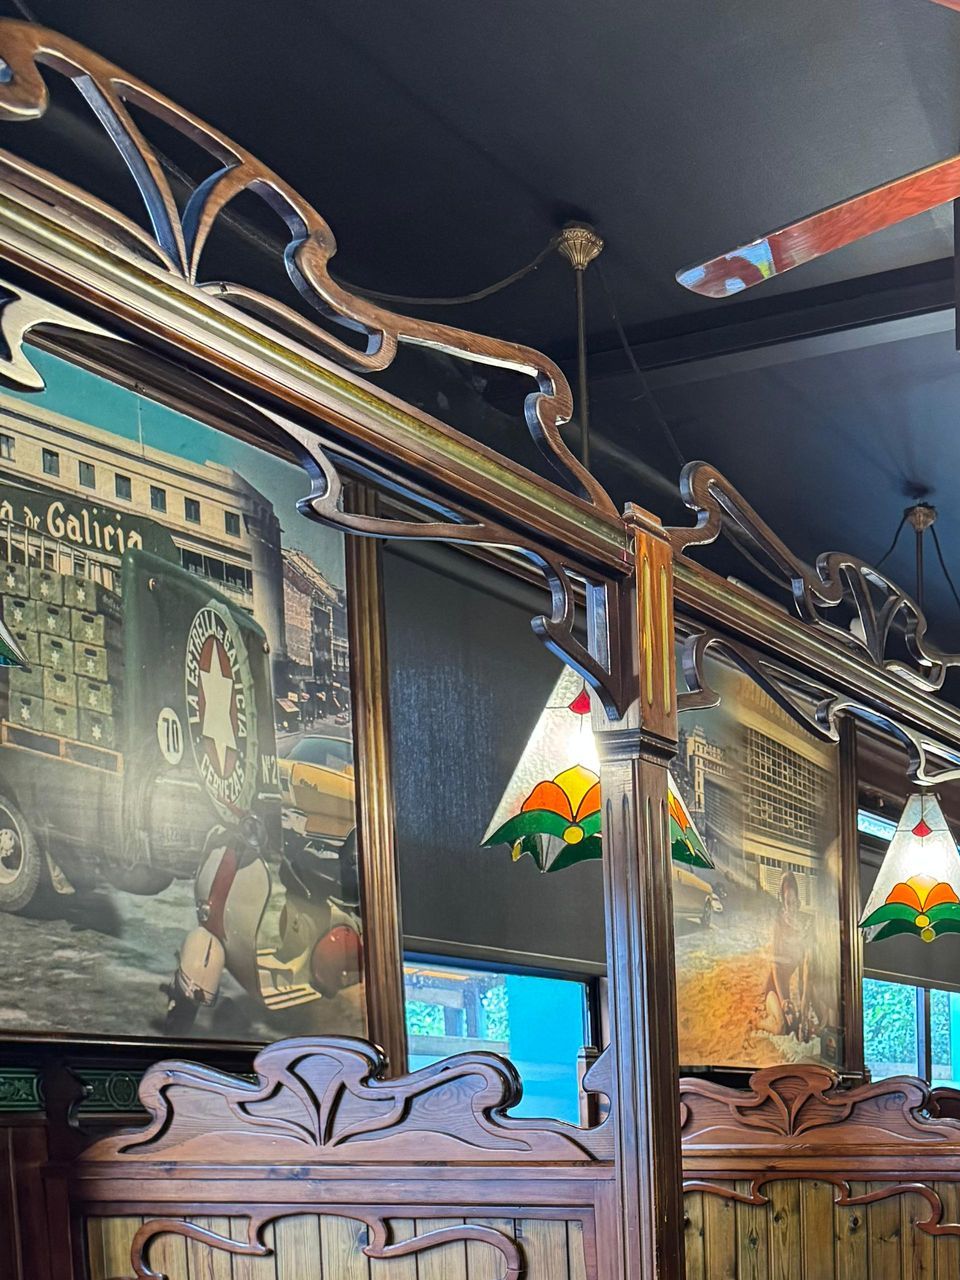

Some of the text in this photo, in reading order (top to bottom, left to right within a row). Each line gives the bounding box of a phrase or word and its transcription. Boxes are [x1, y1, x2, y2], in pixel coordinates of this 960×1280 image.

[46, 501, 143, 555] Galicia
[187, 610, 218, 683] ESTRELLA
[187, 694, 200, 724] LA
[223, 634, 248, 738] GALICIA
[161, 716, 180, 754] 70
[200, 754, 245, 803] CERVEZAS
